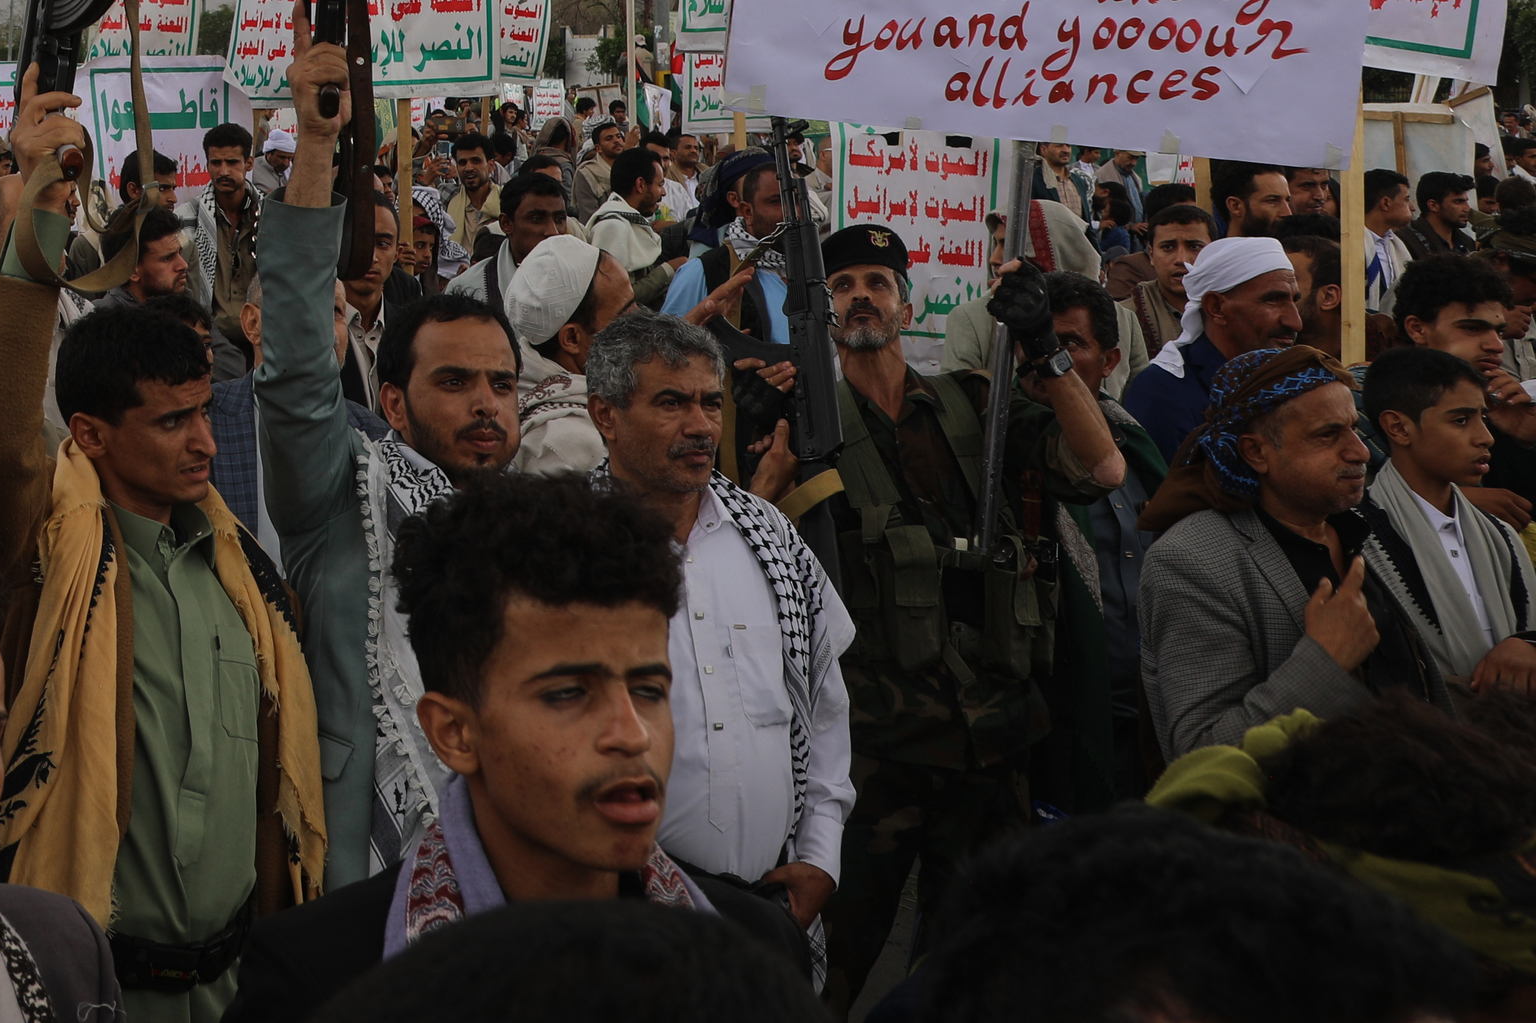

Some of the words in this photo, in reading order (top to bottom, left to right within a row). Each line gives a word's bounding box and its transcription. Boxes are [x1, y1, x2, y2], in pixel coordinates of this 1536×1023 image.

[139, 14, 152, 31] عل
[157, 14, 188, 34] اللعنة
[240, 9, 282, 35] لإسرائيل
[504, 3, 543, 21] الموت
[509, 24, 540, 44] اللعنة
[825, 13, 928, 81] you
[932, 1, 1030, 52] and
[236, 39, 265, 60] اليهود
[267, 40, 287, 61] على
[413, 22, 483, 73] النصر
[501, 47, 536, 70] النص
[694, 74, 721, 91] ليهود
[944, 56, 1221, 110] alliances
[848, 137, 919, 176] لأمريكا
[924, 150, 988, 181] الموت
[847, 183, 919, 226] لإسرائيل
[924, 195, 985, 226] الموت
[937, 236, 983, 268] اللعنة
